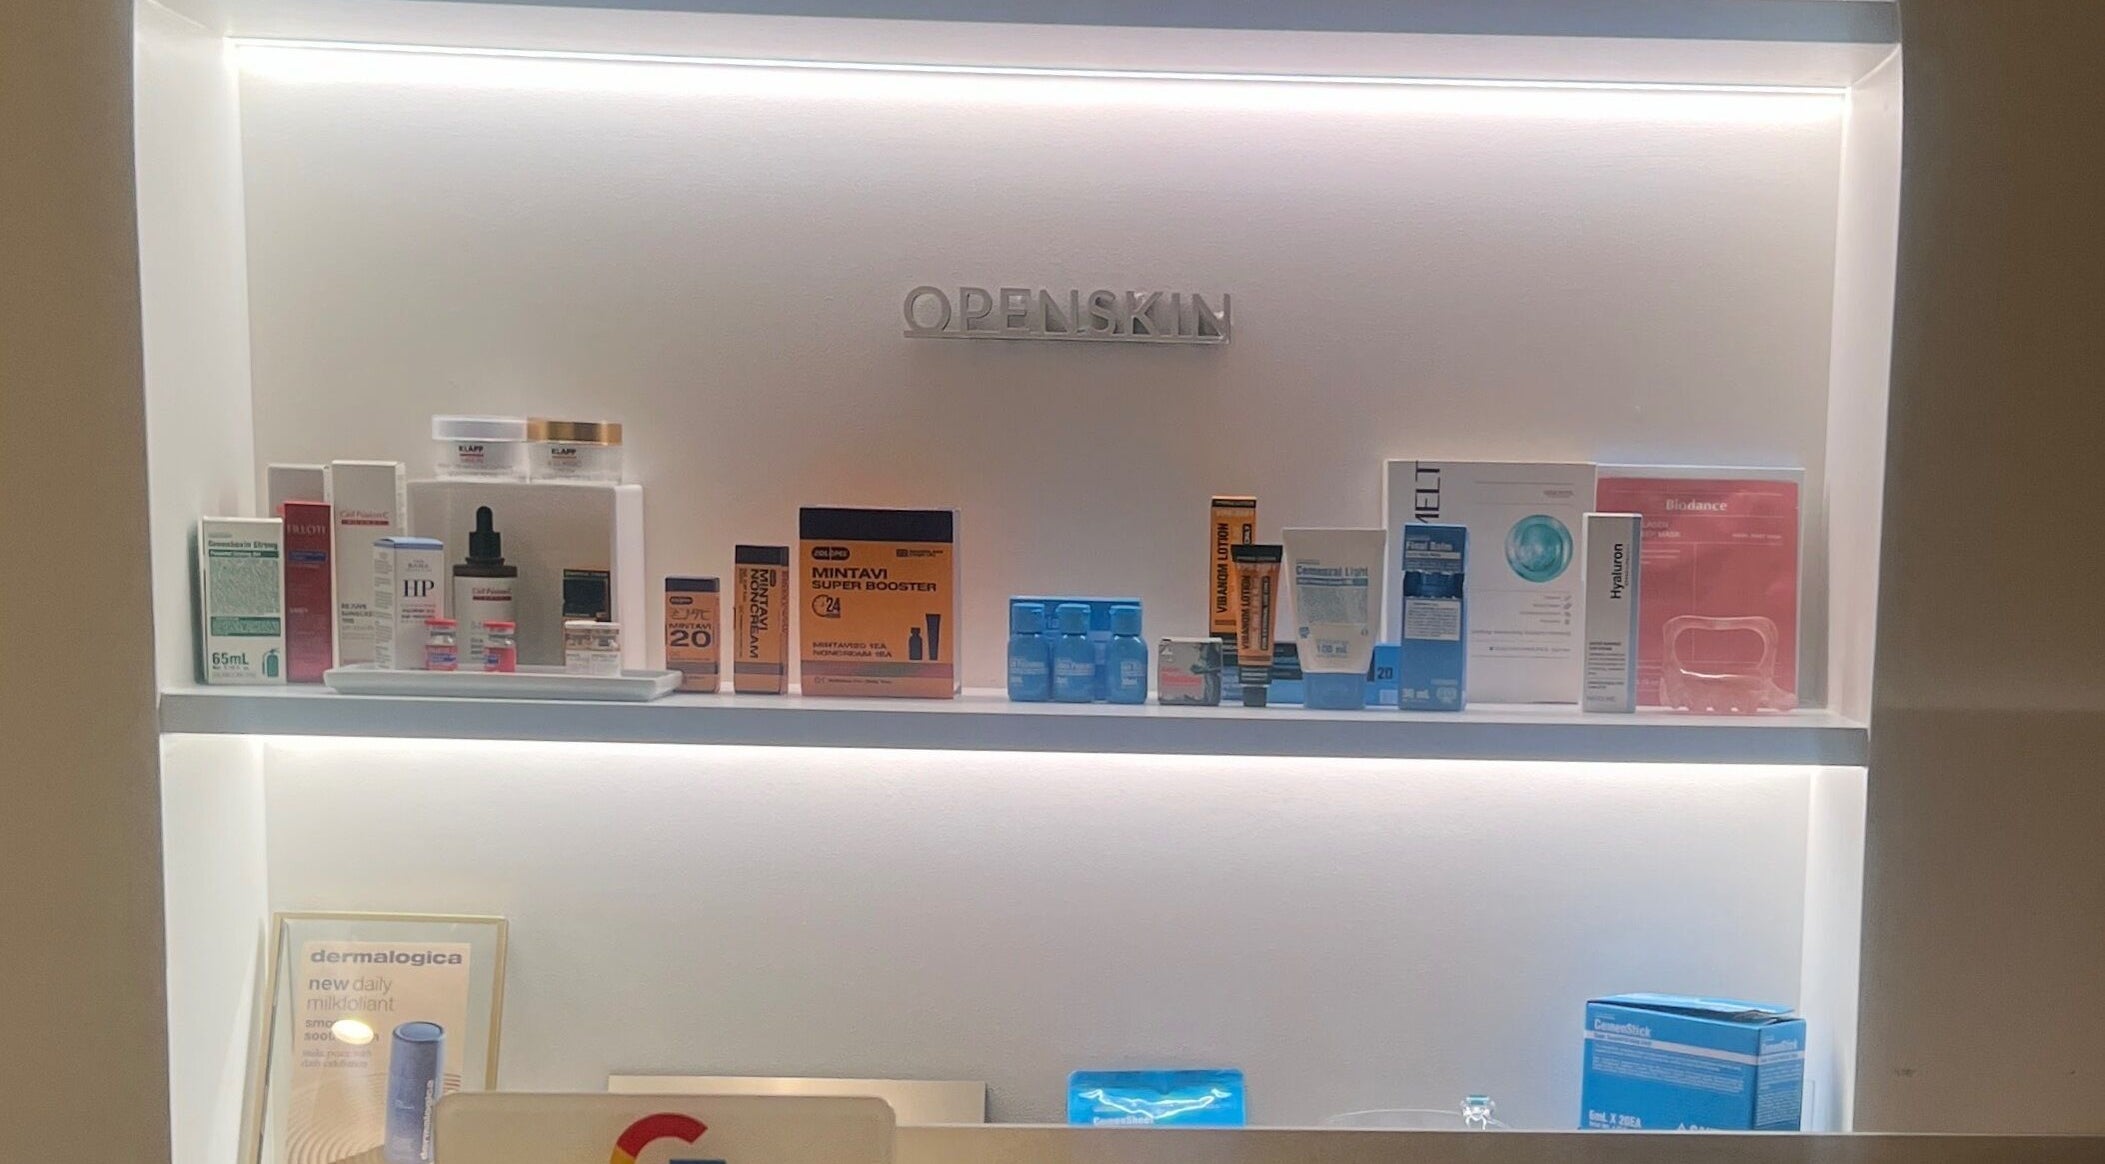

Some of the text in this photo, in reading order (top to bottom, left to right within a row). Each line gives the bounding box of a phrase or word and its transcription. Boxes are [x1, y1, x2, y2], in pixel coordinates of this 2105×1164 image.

[903, 285, 1231, 338] OPENSKIN
[1665, 498, 1728, 511] Biodance
[1216, 523, 1229, 561] LOTION
[812, 567, 888, 579] MINTAVI
[1610, 543, 1624, 599] Hyaluron
[402, 580, 435, 597] HP
[812, 580, 937, 592] SUPER BOOSTER
[1241, 575, 1251, 607] LOTION
[759, 569, 769, 631] MINTAVI
[750, 569, 760, 659] NONCREAM
[670, 630, 711, 648] 20
[212, 652, 249, 665] 65mL
[1377, 667, 1394, 680] 20
[310, 949, 463, 967] dermalogica
[308, 976, 393, 994] new daily
[306, 996, 395, 1013] milkfoliant
